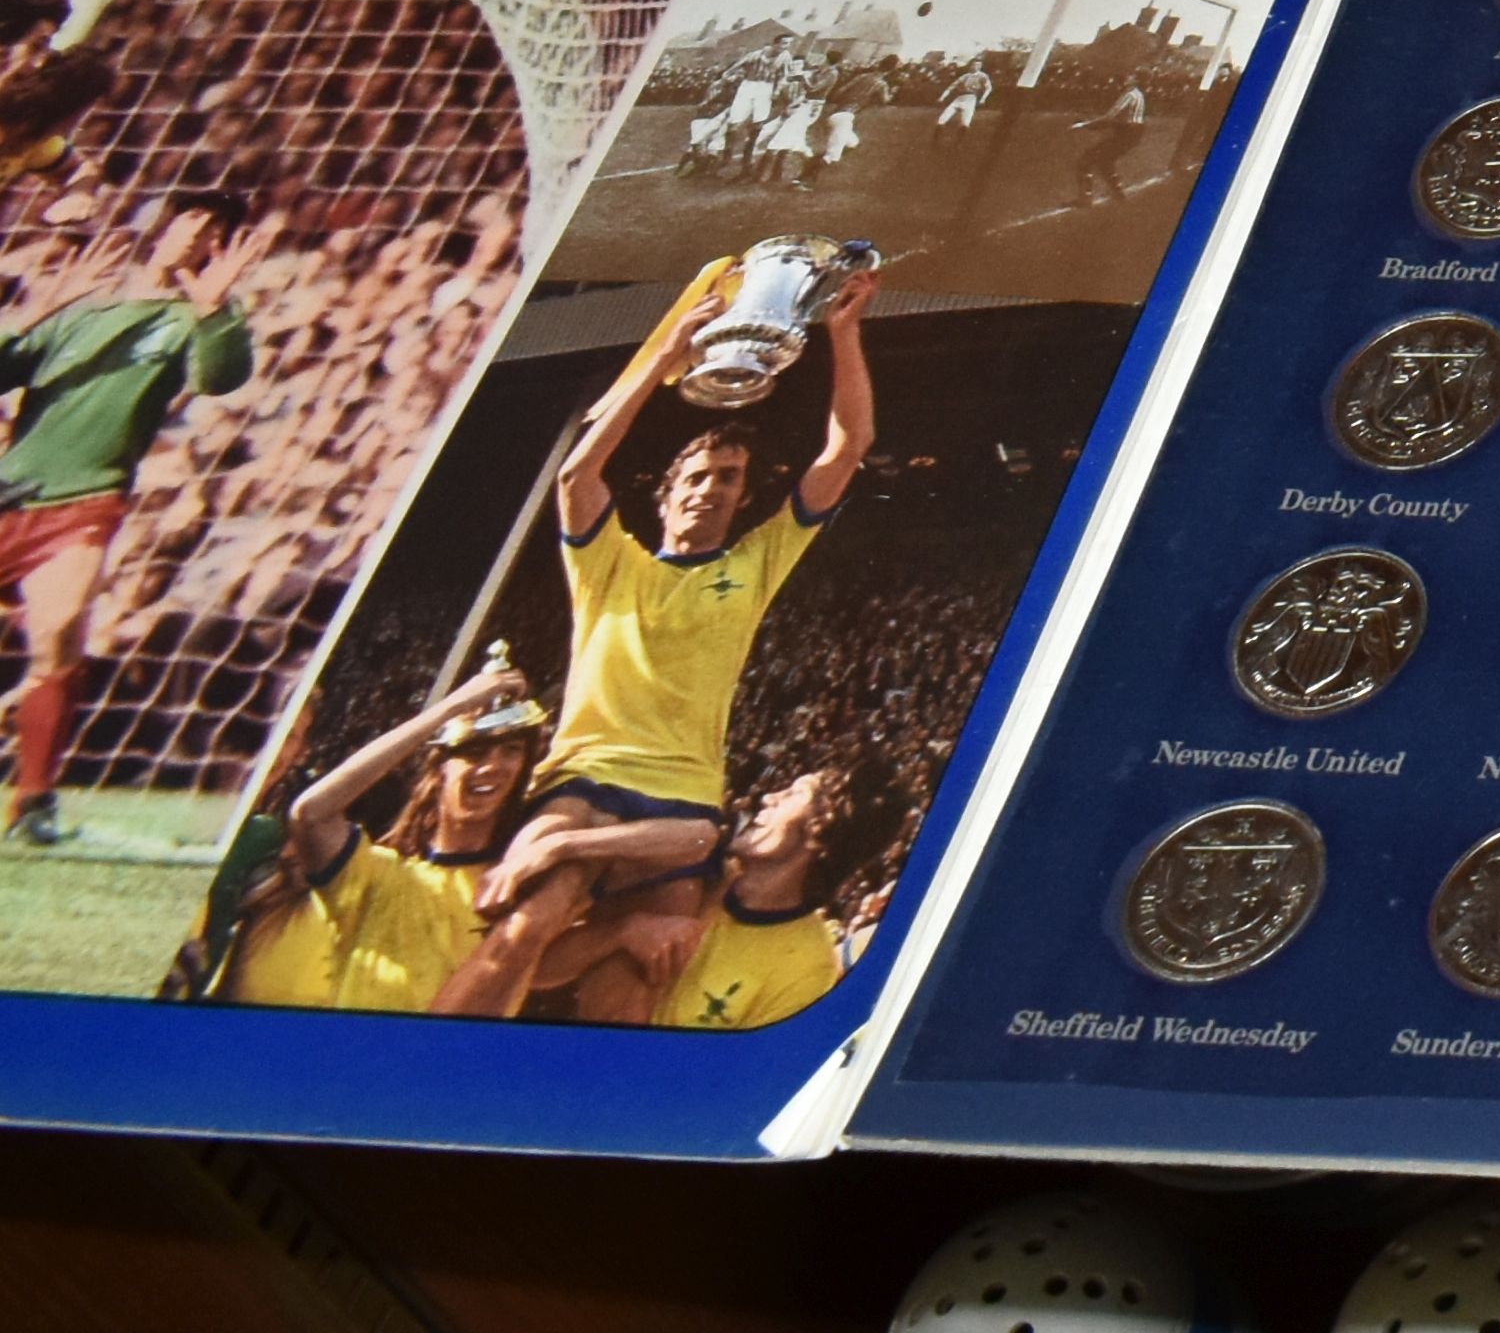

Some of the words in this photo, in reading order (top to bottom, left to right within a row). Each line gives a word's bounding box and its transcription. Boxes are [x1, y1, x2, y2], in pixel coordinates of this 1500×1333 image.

[1379, 258, 1499, 281] Bradford
[1280, 489, 1363, 518] Derby
[1368, 493, 1469, 522] County
[1153, 741, 1298, 770] Newcastle
[1306, 748, 1405, 775] United
[1007, 1010, 1144, 1040] Sheffield
[1154, 1017, 1316, 1053] Wednesday
